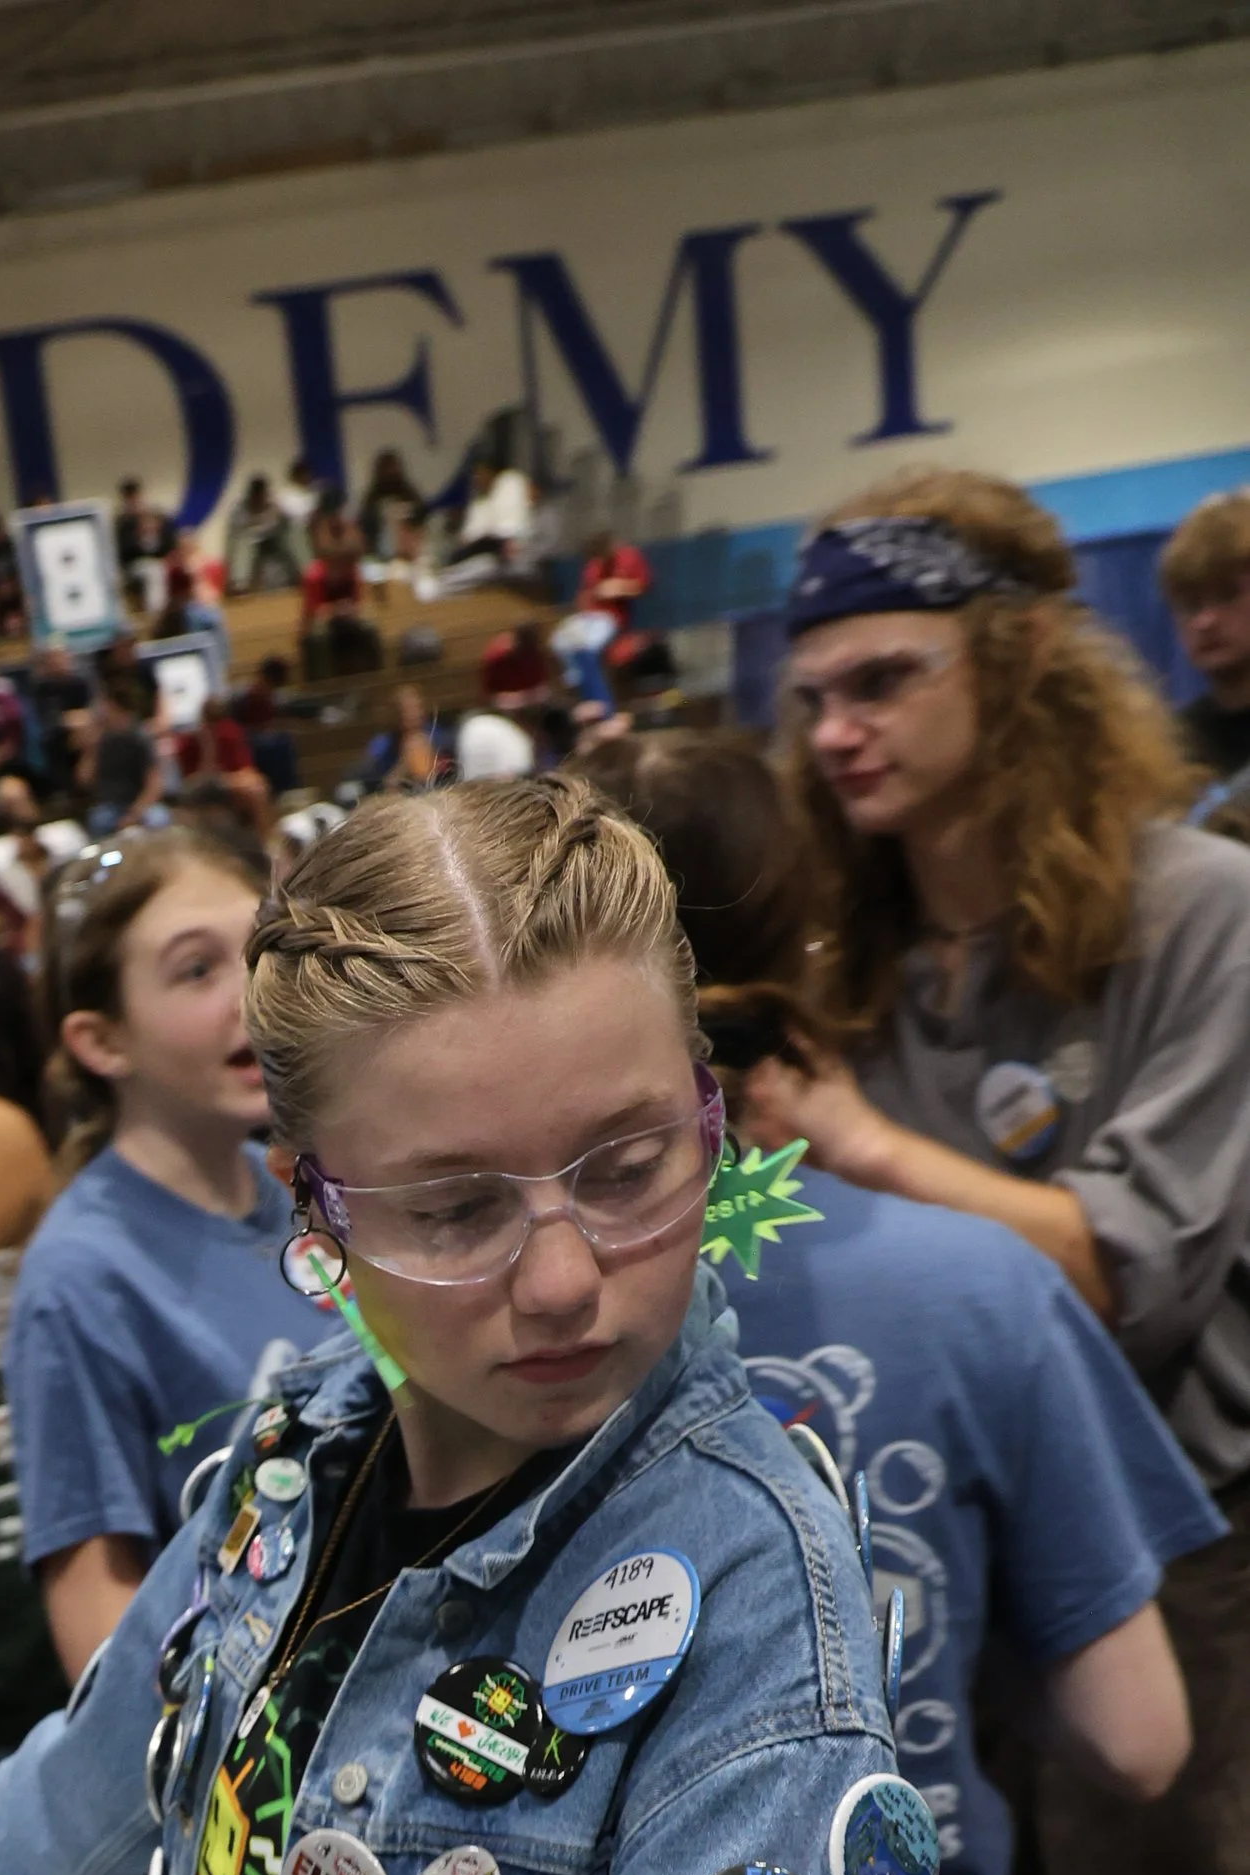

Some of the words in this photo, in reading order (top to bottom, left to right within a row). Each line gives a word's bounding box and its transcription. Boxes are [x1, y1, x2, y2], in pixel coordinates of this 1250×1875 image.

[604, 1555, 655, 1590] 4189
[567, 1592, 675, 1643] REEFSCAPE
[560, 1676, 602, 1701] DRIVE
[607, 1666, 651, 1689] TEAM
